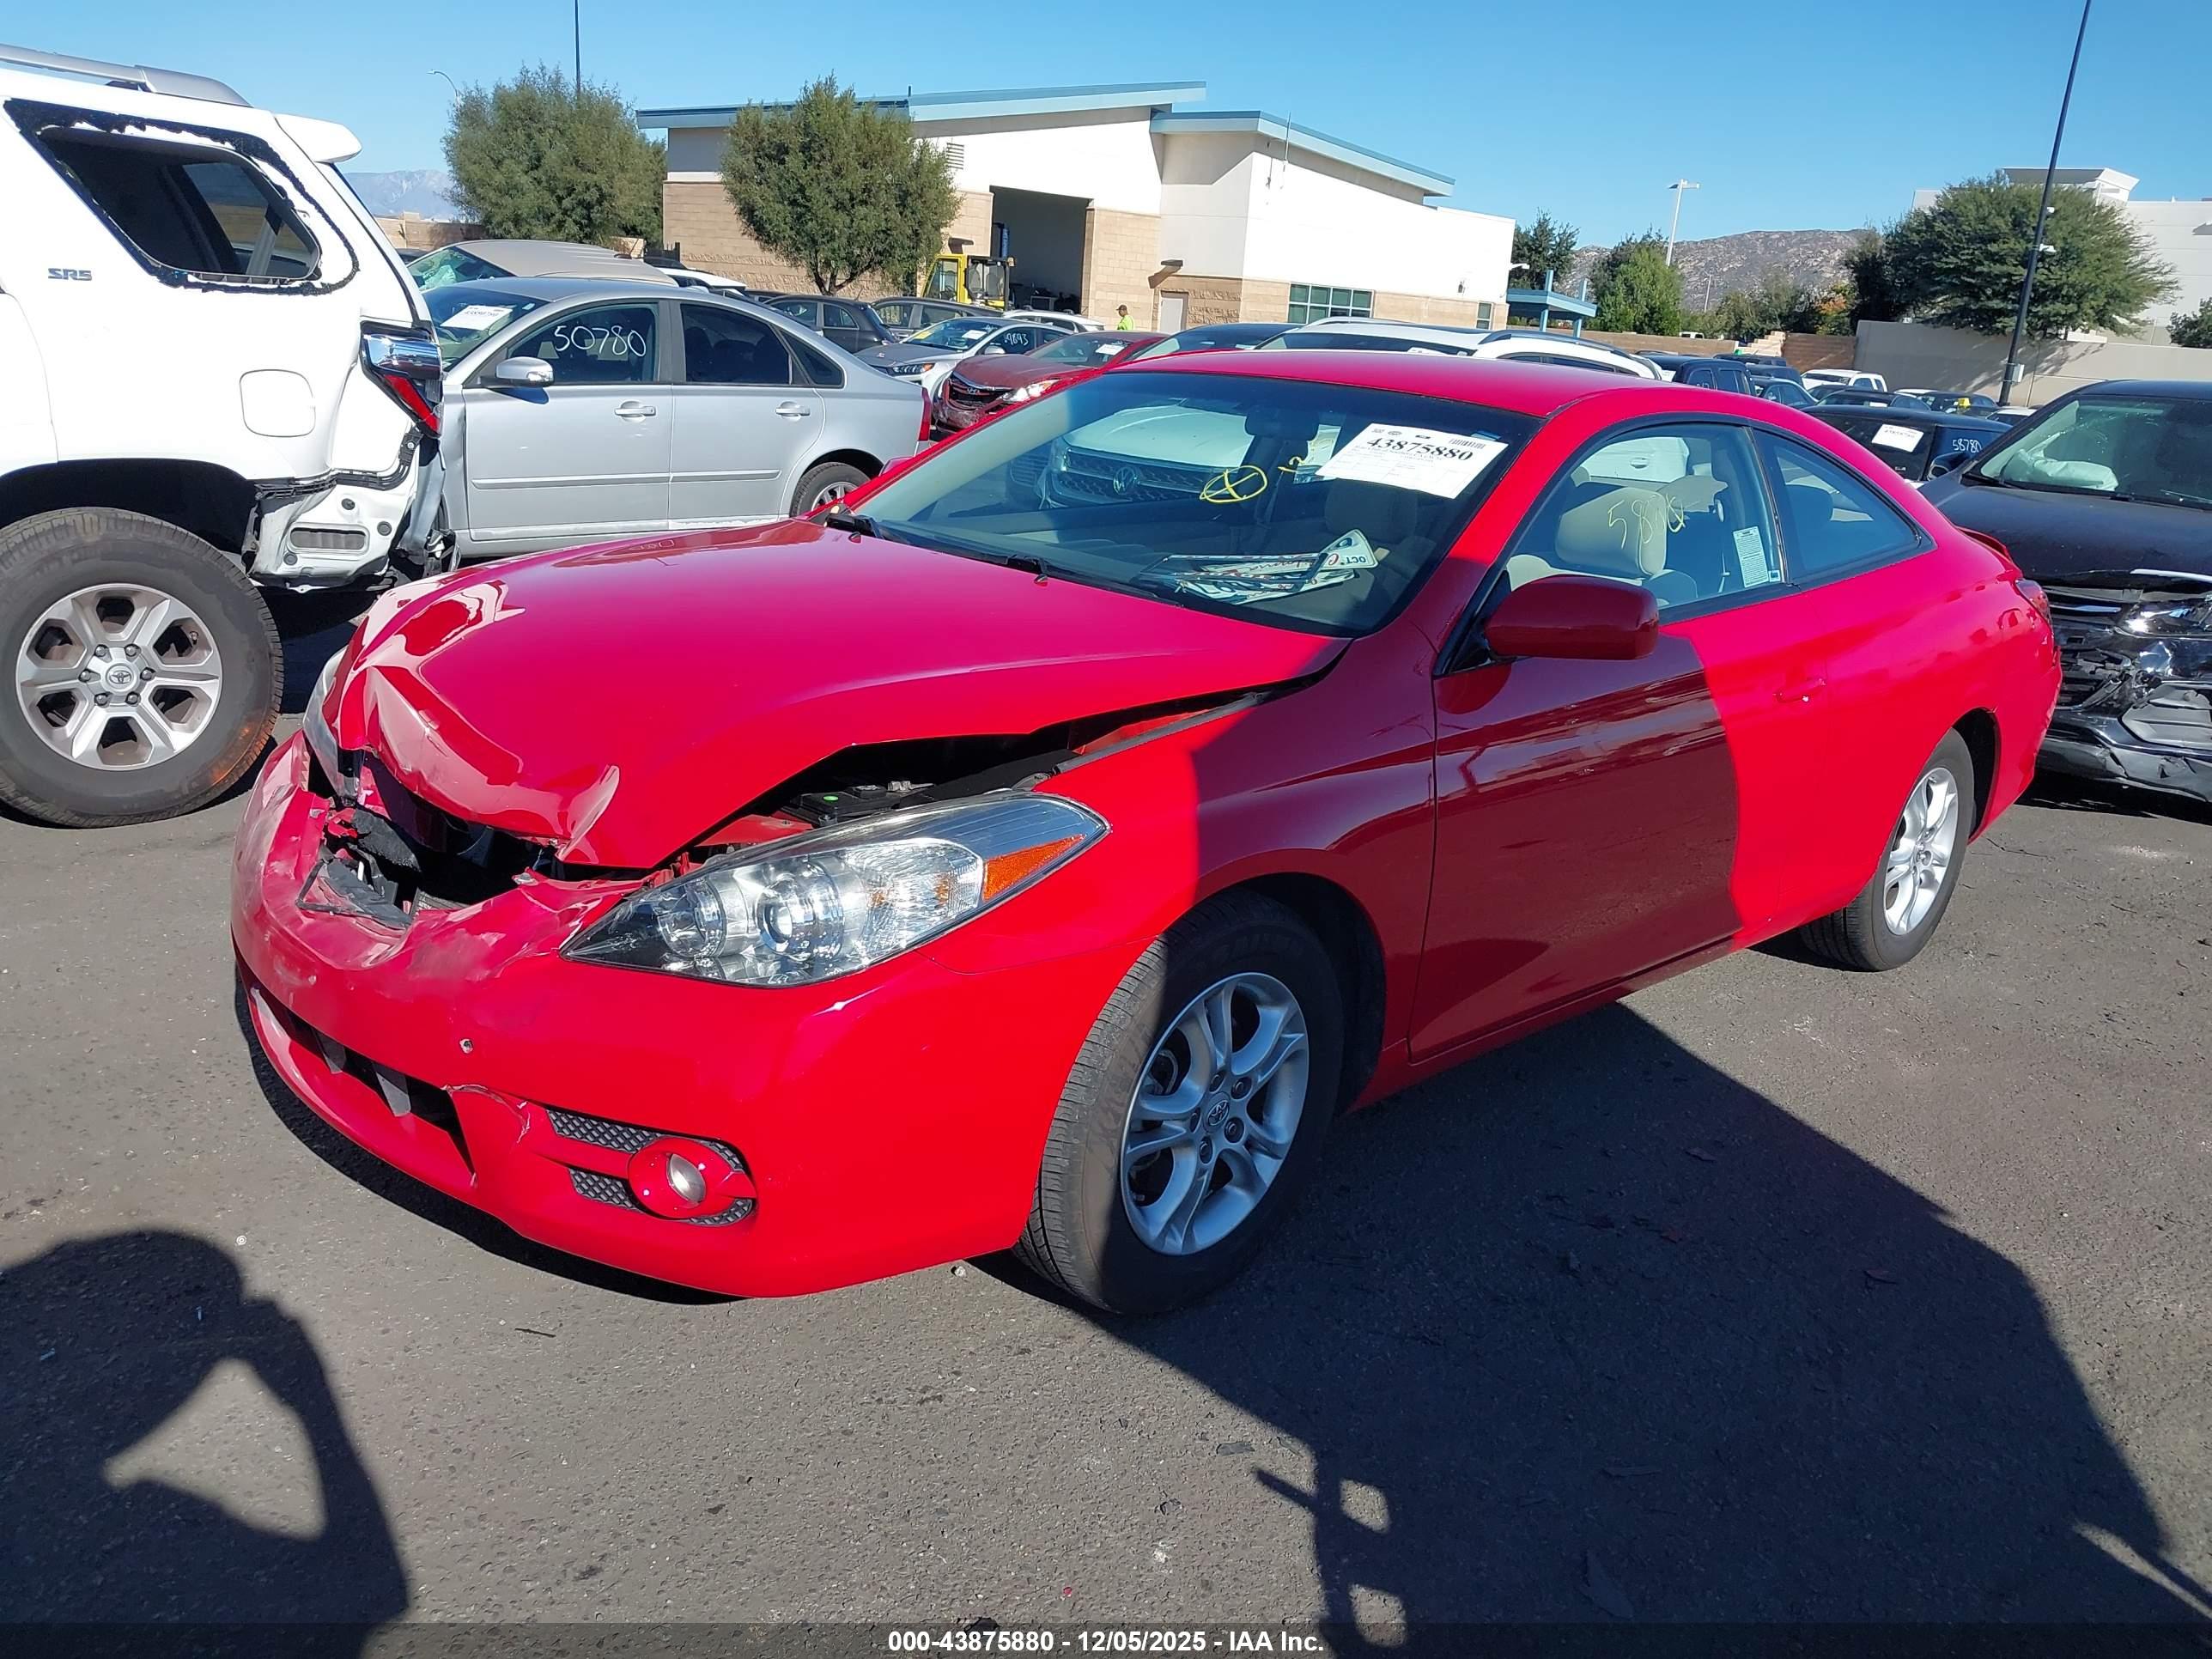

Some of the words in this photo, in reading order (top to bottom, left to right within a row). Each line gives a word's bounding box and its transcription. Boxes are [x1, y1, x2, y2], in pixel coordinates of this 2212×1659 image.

[48, 268, 92, 281] SR5
[554, 325, 647, 356] 50780
[1366, 437, 1474, 461] 43875880
[1345, 556, 1366, 564] OCT
